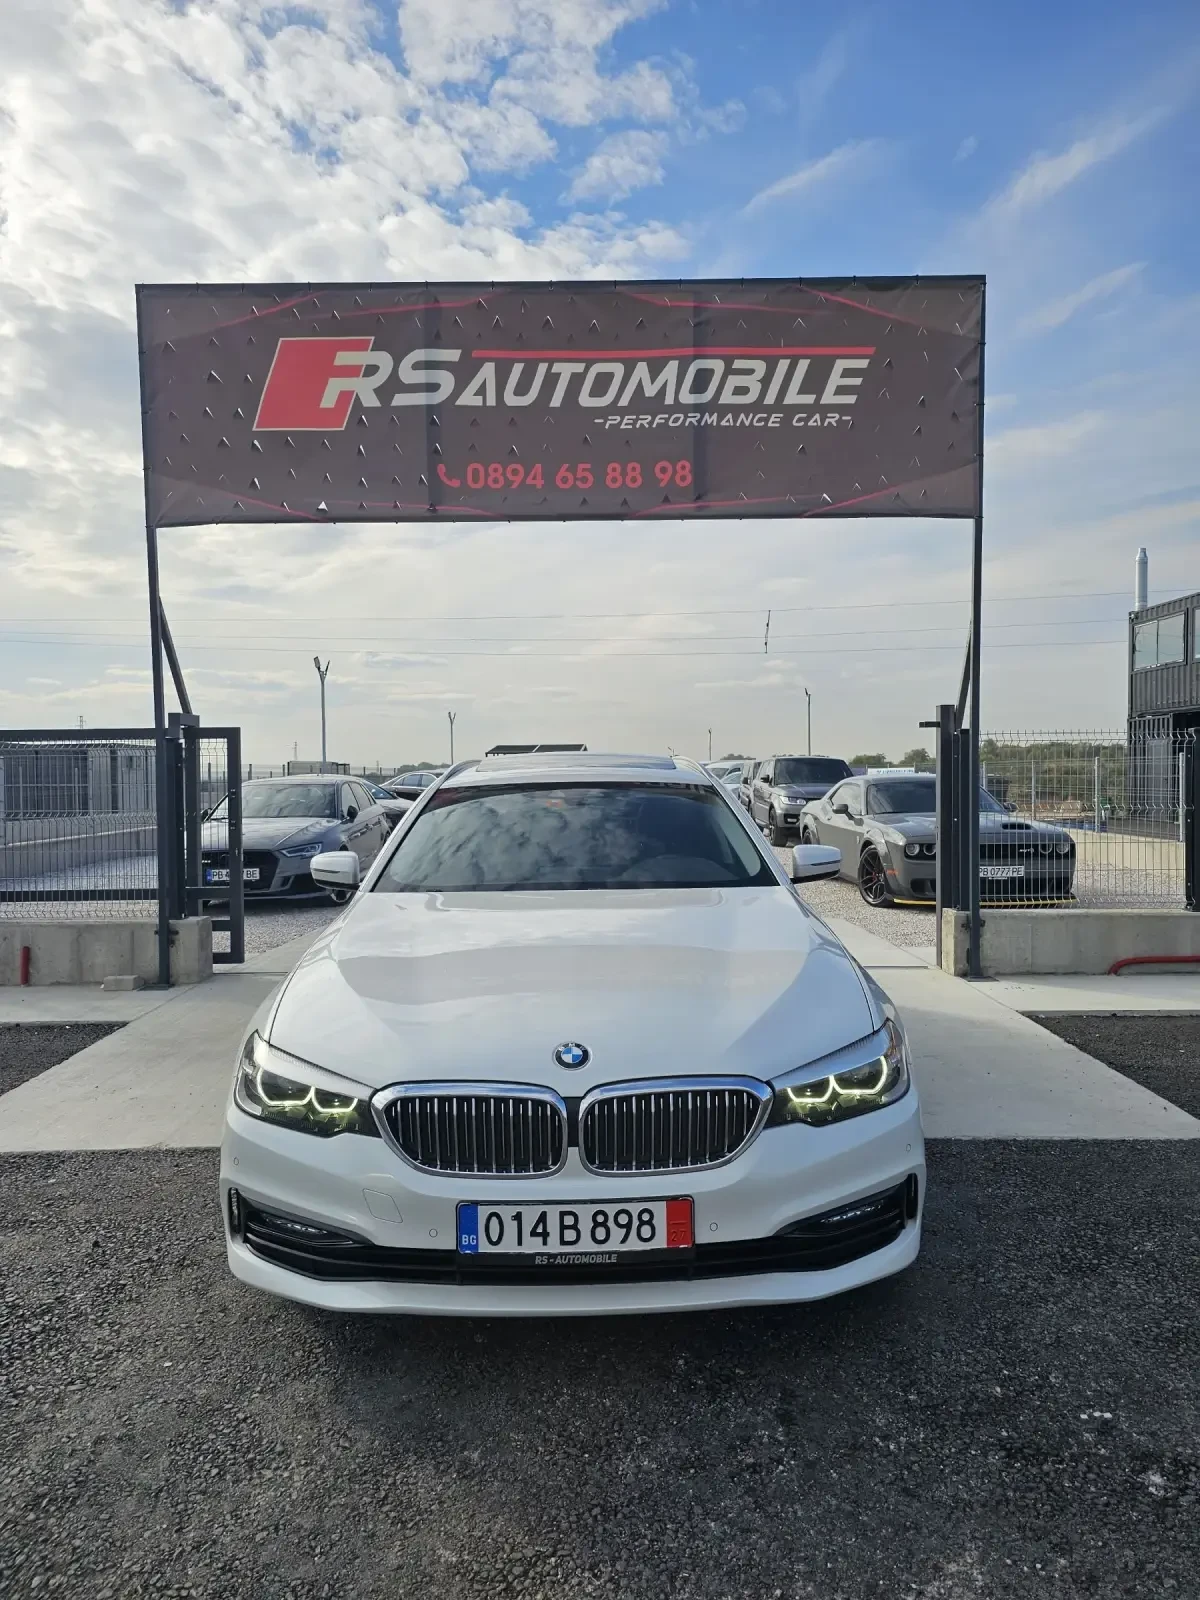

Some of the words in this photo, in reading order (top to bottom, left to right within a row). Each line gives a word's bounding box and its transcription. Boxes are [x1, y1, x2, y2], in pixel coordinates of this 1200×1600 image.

[454, 358, 871, 407] AUTOMOBILE
[466, 463, 545, 489] 0894
[555, 464, 594, 489] 65
[605, 462, 643, 488] 88
[654, 460, 692, 487] 98
[990, 867, 1010, 876] 0777
[462, 1234, 477, 1245] BG
